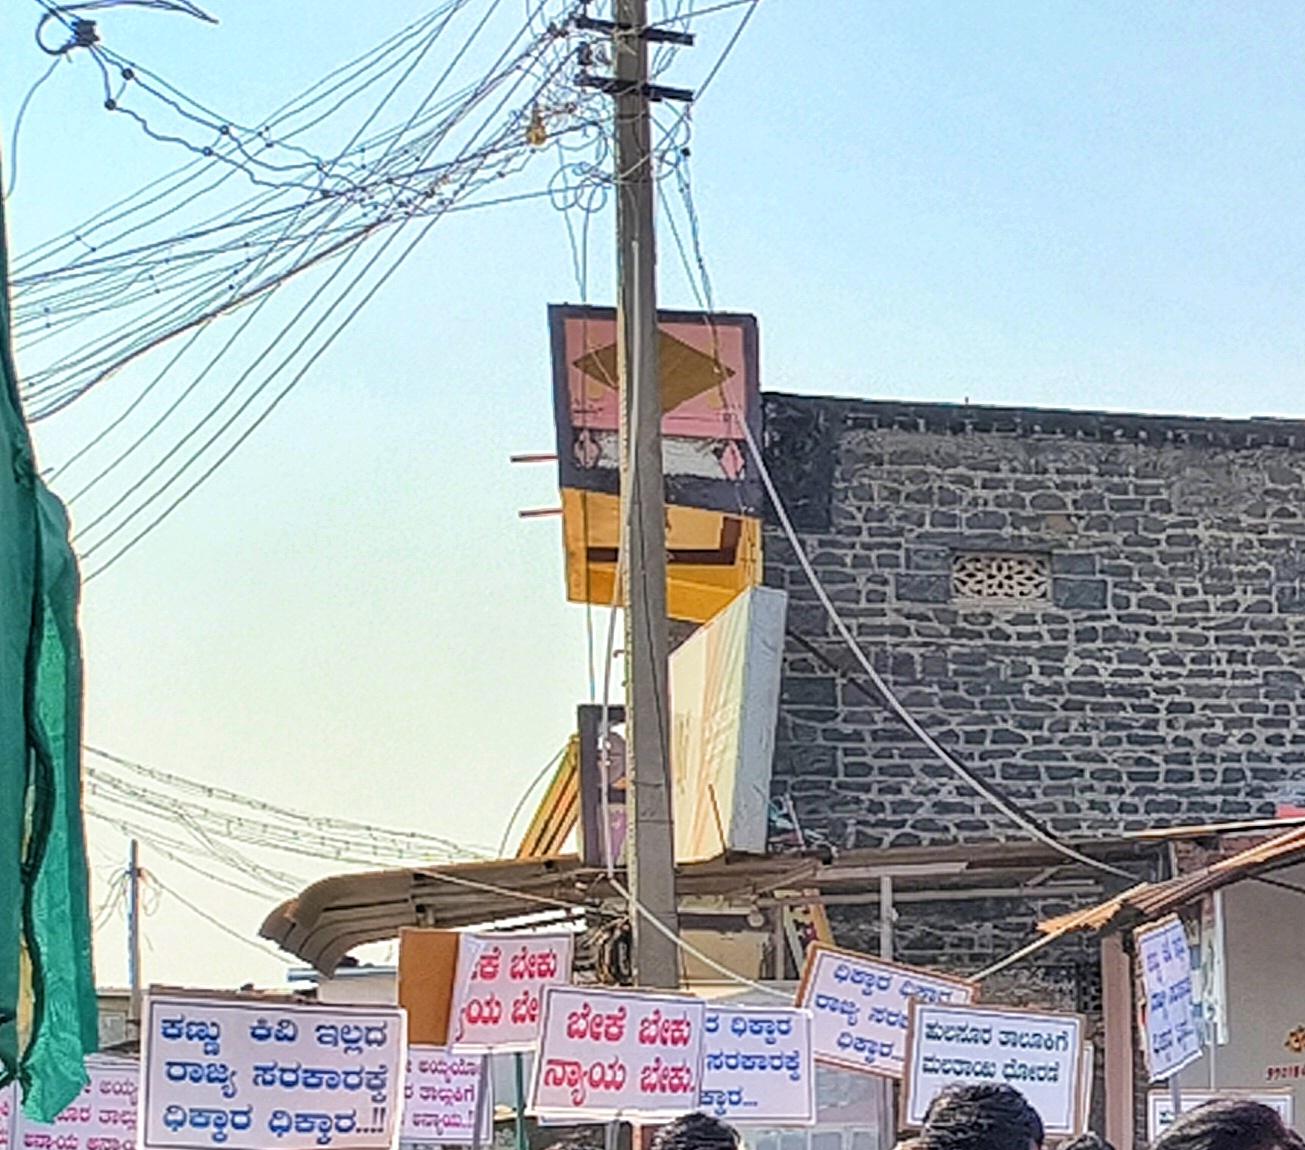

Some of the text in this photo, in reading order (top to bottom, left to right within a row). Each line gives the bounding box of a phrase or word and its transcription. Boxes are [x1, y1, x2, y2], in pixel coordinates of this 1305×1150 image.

[472, 946, 558, 981] ಕೆ ಬೇಕು
[511, 991, 540, 1024] ಬೇ
[566, 1002, 627, 1045] ಬೇಕೆ
[639, 1008, 692, 1046] ಬೇಕು
[161, 1013, 388, 1056] ಕಣ್ಣು ಕಿವಿ ಇಲ್ಲದ
[730, 1014, 792, 1045] ಧಿಕ್ಕಾರ
[165, 1059, 238, 1099] ರಾಜ್ಯ
[253, 1059, 389, 1104] ಸರಕಾರಕ್ಕೆ
[544, 1055, 627, 1106] ನ್ಯಾಯ
[705, 1049, 801, 1082] ಸರಕಾರಕ್ಕೆ
[163, 1103, 254, 1143] ಧಿಕ್ಕಾರ
